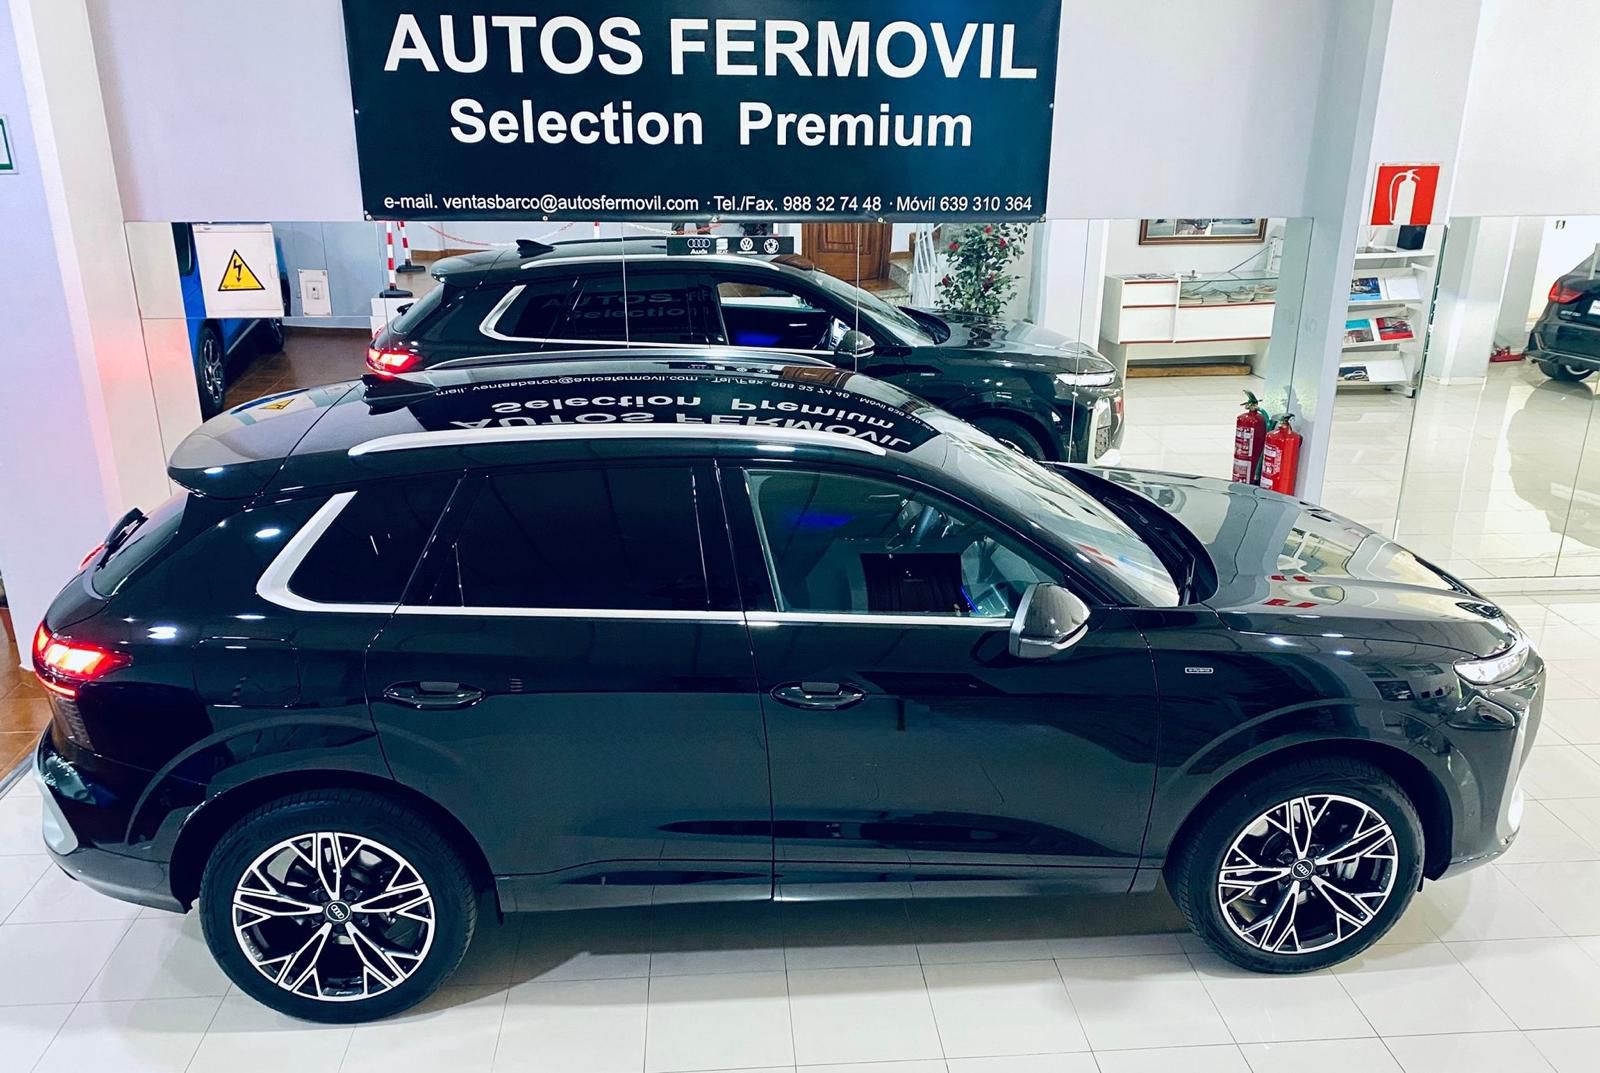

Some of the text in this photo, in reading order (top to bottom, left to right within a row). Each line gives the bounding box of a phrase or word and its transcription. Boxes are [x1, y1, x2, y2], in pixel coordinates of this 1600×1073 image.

[383, 13, 1038, 79] AUTOS FERMOVIL
[450, 98, 972, 147] Selection Premium
[383, 193, 1033, 214] e-mail. ventasbarco@autosfermovil.com Tel./Fax. 988 32 74 48 Móvil 639 310 364
